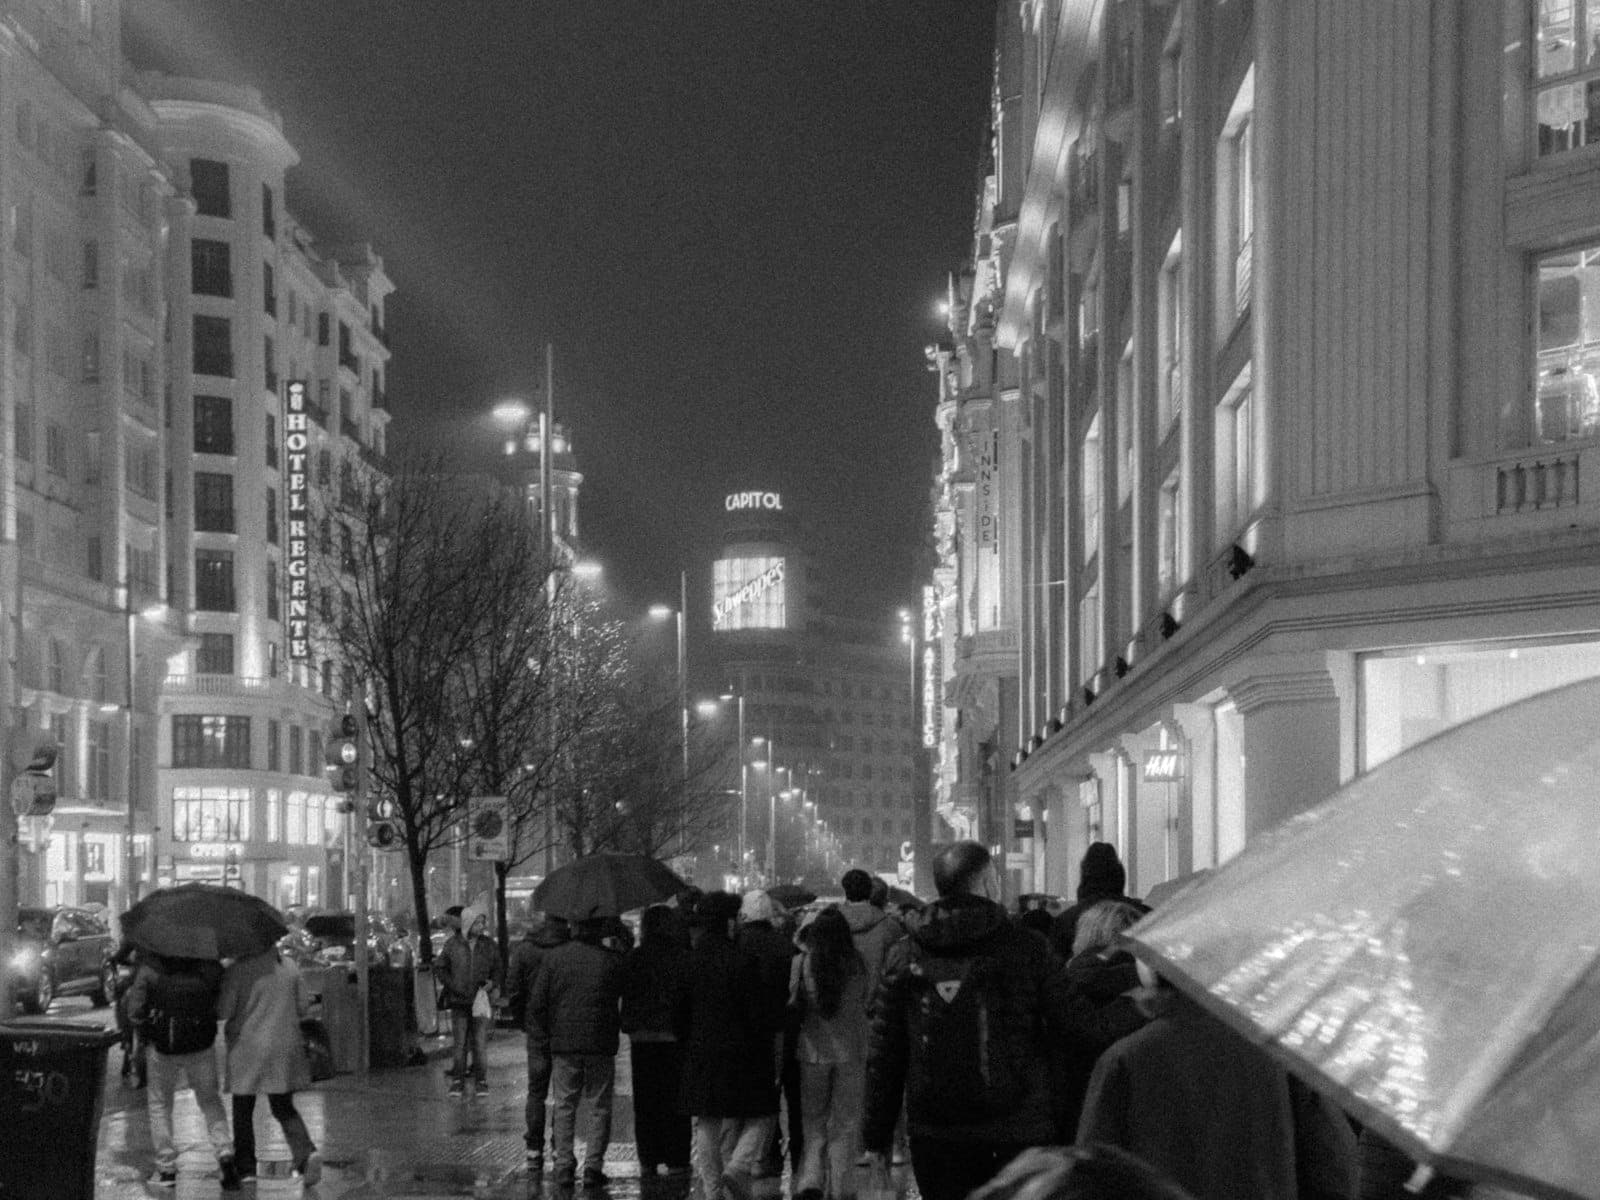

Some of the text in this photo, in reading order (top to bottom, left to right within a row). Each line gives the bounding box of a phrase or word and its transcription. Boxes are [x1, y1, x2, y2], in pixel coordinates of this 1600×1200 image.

[725, 491, 783, 511] CAPITOL
[981, 441, 991, 541] INNSIDE
[287, 413, 308, 657] HOTEL REGENTE
[713, 562, 784, 625] Schweppes
[1144, 755, 1177, 777] H&M
